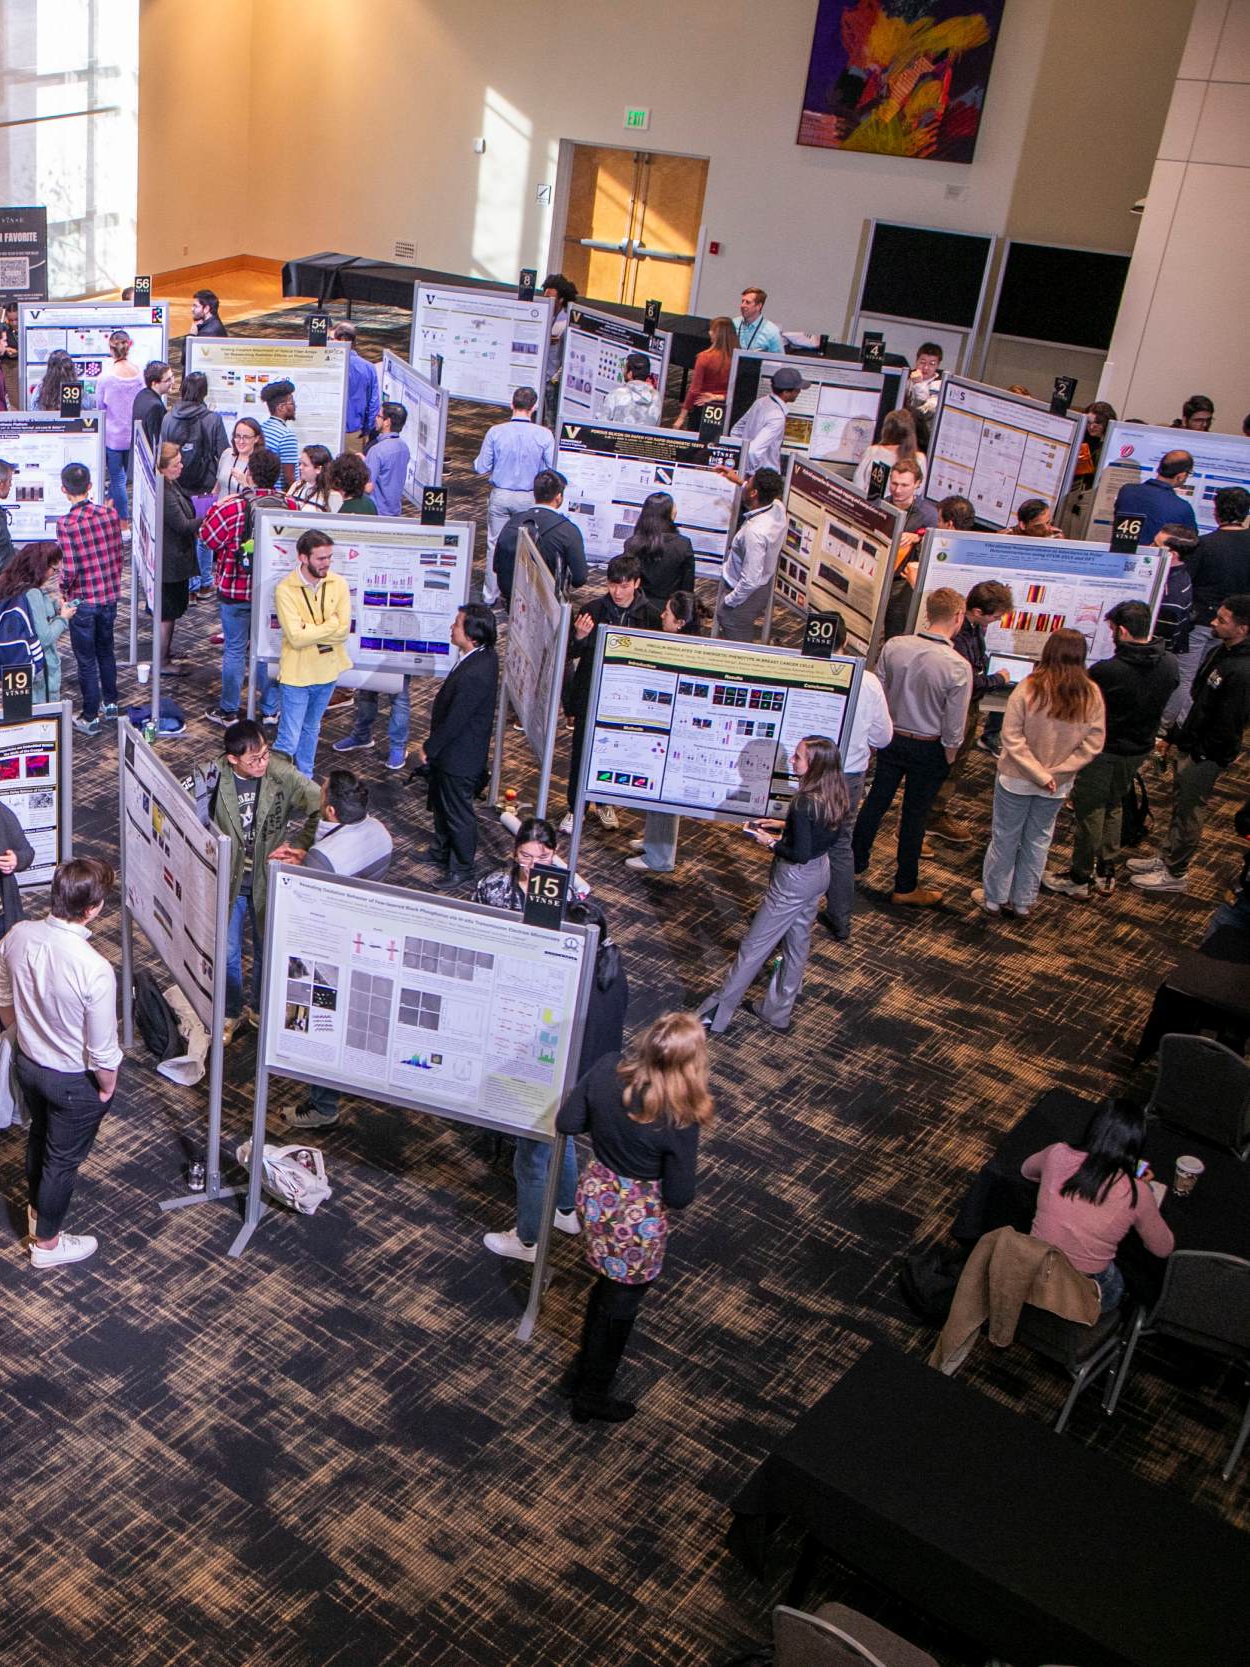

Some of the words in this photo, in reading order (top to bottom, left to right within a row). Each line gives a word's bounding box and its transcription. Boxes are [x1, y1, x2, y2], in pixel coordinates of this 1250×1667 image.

[4, 231, 37, 243] FAVORITE
[135, 278, 150, 288] 56
[311, 318, 326, 329] 54
[870, 345, 879, 356] 4
[62, 387, 80, 400] 39
[1057, 383, 1066, 395] 2
[704, 406, 723, 420] 50
[564, 425, 581, 439] V
[425, 491, 444, 507] 34
[1117, 519, 1142, 535] 46
[808, 621, 833, 638] 30
[4, 672, 28, 690] 19
[803, 682, 835, 692] Conclusions
[530, 875, 559, 898] 15
[529, 894, 561, 907] VINSE
